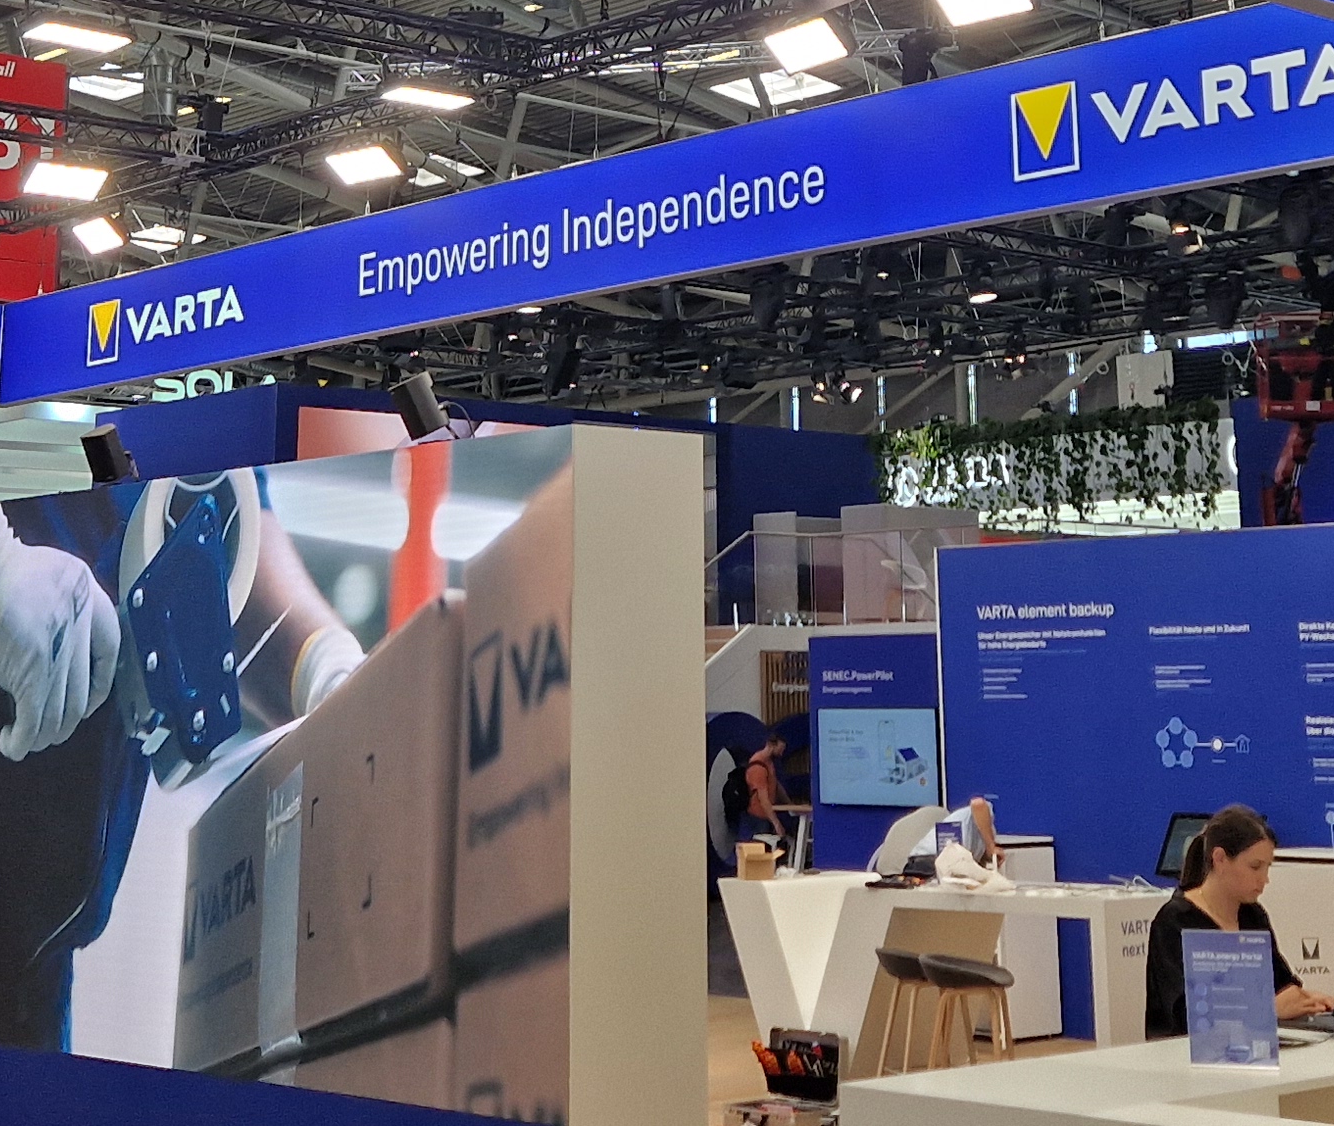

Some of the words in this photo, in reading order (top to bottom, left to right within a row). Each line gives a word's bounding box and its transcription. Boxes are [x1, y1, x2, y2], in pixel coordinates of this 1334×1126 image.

[358, 219, 551, 298] Empowering
[561, 164, 826, 254] Independence
[126, 285, 244, 344] VARTA
[977, 605, 1016, 620] VARTA
[1017, 604, 1067, 618] element
[1069, 602, 1115, 618] backup
[1122, 944, 1145, 958] next
[1294, 965, 1331, 975] VARTA
